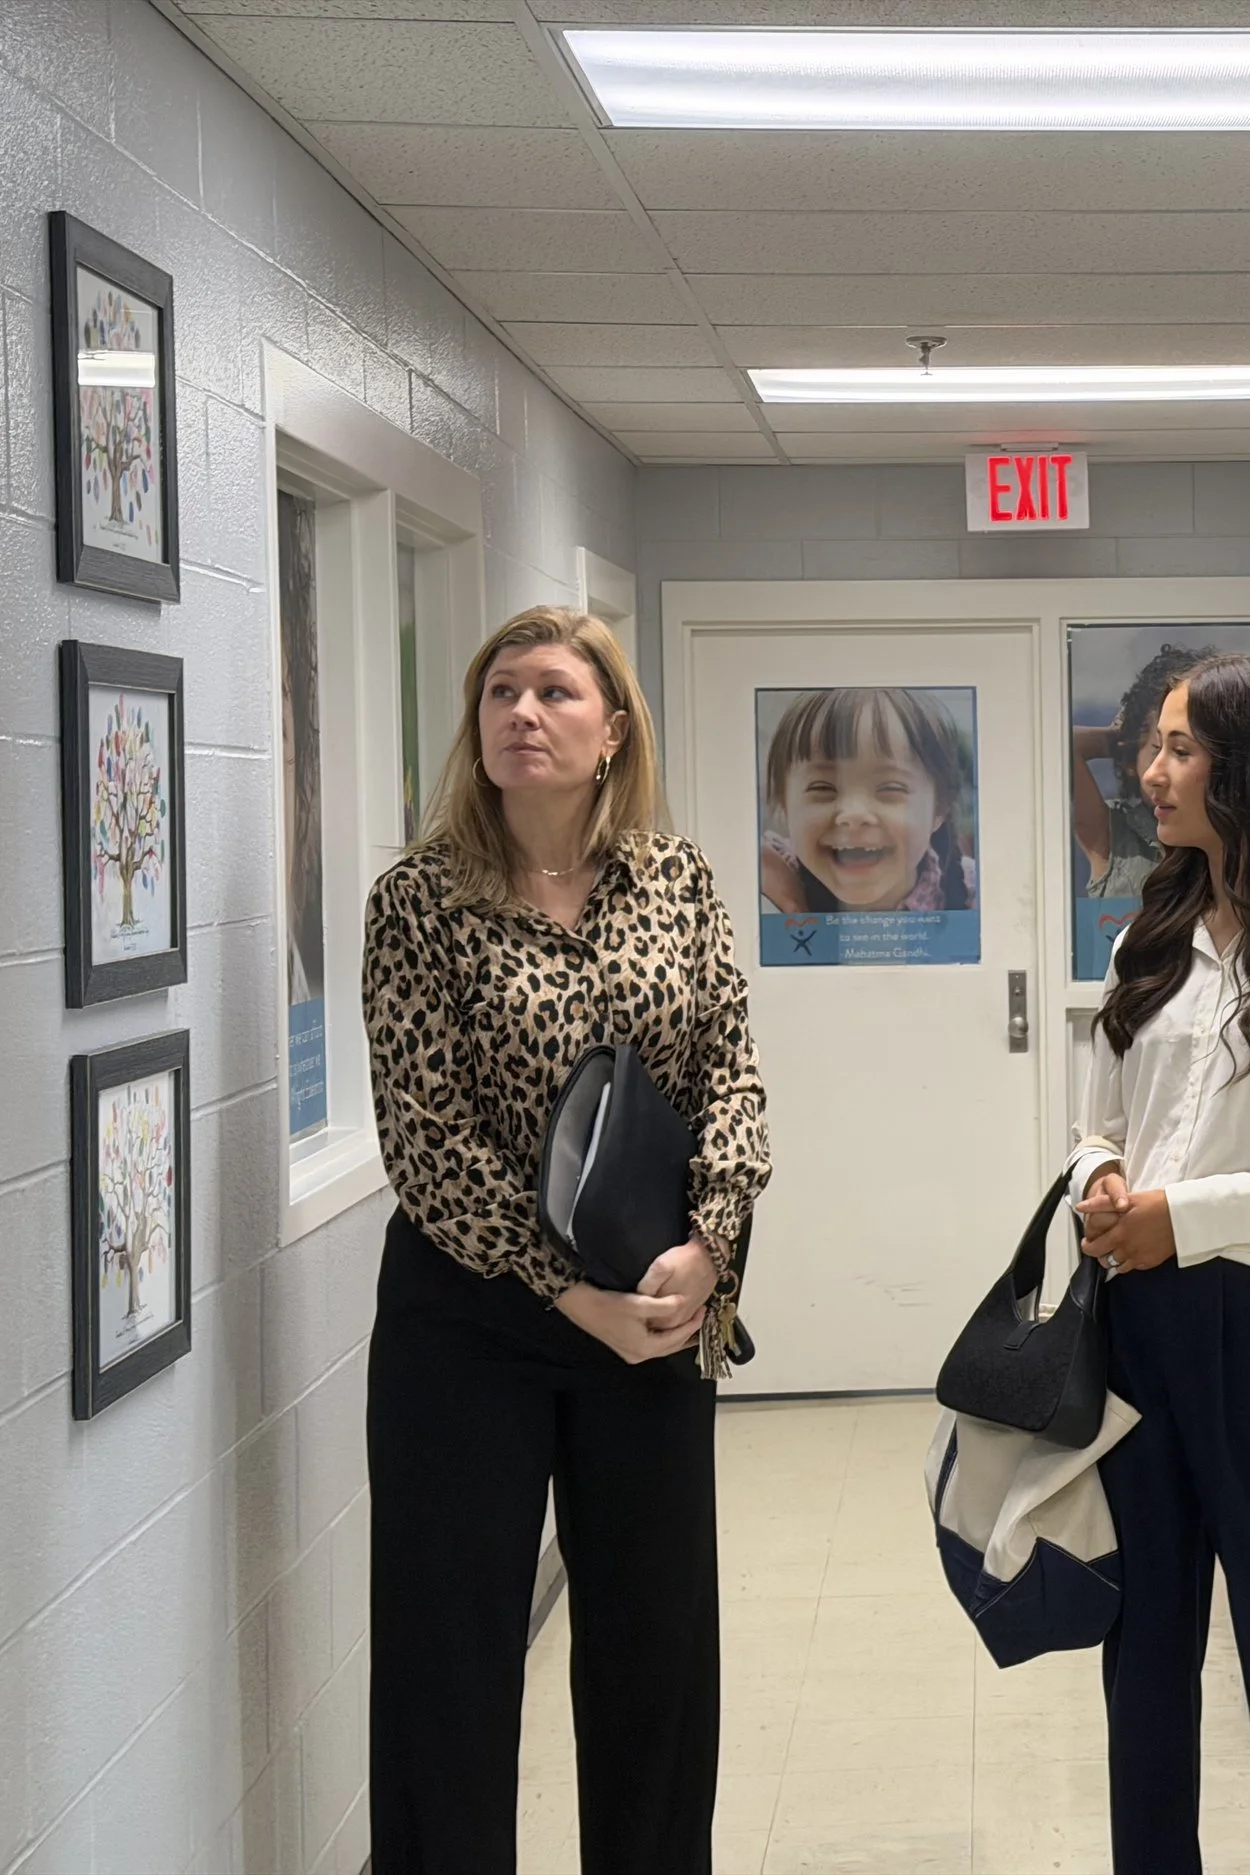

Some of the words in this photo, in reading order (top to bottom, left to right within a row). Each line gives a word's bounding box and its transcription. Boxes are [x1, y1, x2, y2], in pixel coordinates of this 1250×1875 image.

[987, 454, 1073, 522] EXIT
[826, 915, 840, 926] Be
[842, 914, 859, 925] the
[860, 915, 894, 929] change
[896, 916, 915, 928] you
[839, 933, 851, 943] to
[852, 934, 869, 944] see
[871, 932, 881, 942] in
[882, 931, 899, 942] the
